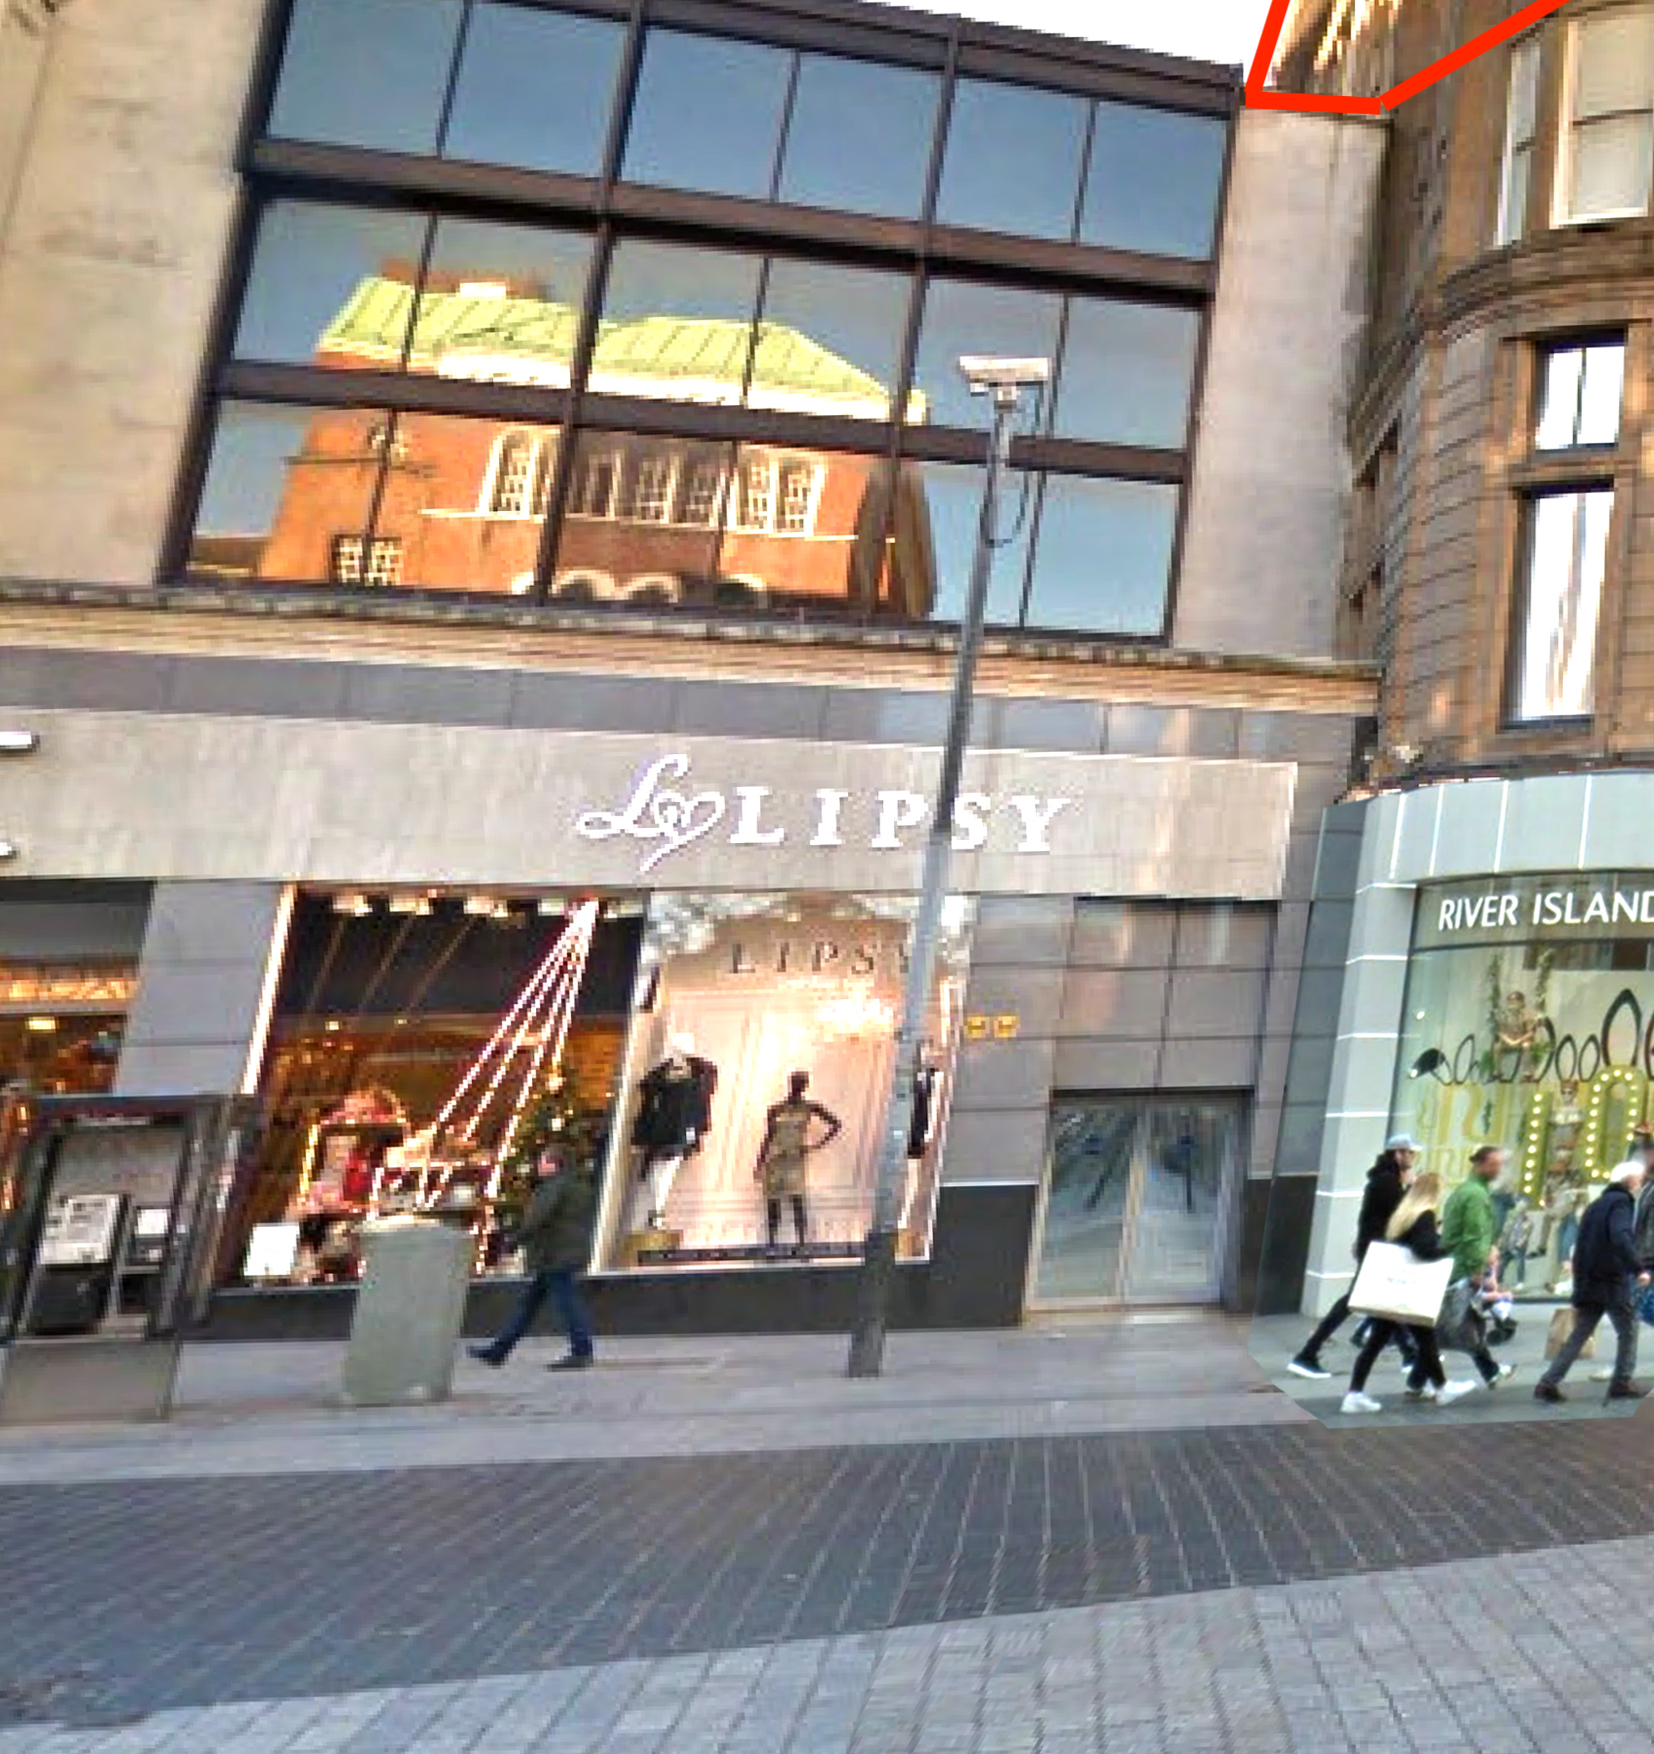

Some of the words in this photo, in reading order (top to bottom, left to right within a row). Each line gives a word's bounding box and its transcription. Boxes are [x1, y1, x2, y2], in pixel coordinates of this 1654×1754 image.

[729, 786, 1073, 853] LIPSY
[1438, 895, 1519, 931] RIVER
[731, 941, 908, 975] LIPS
